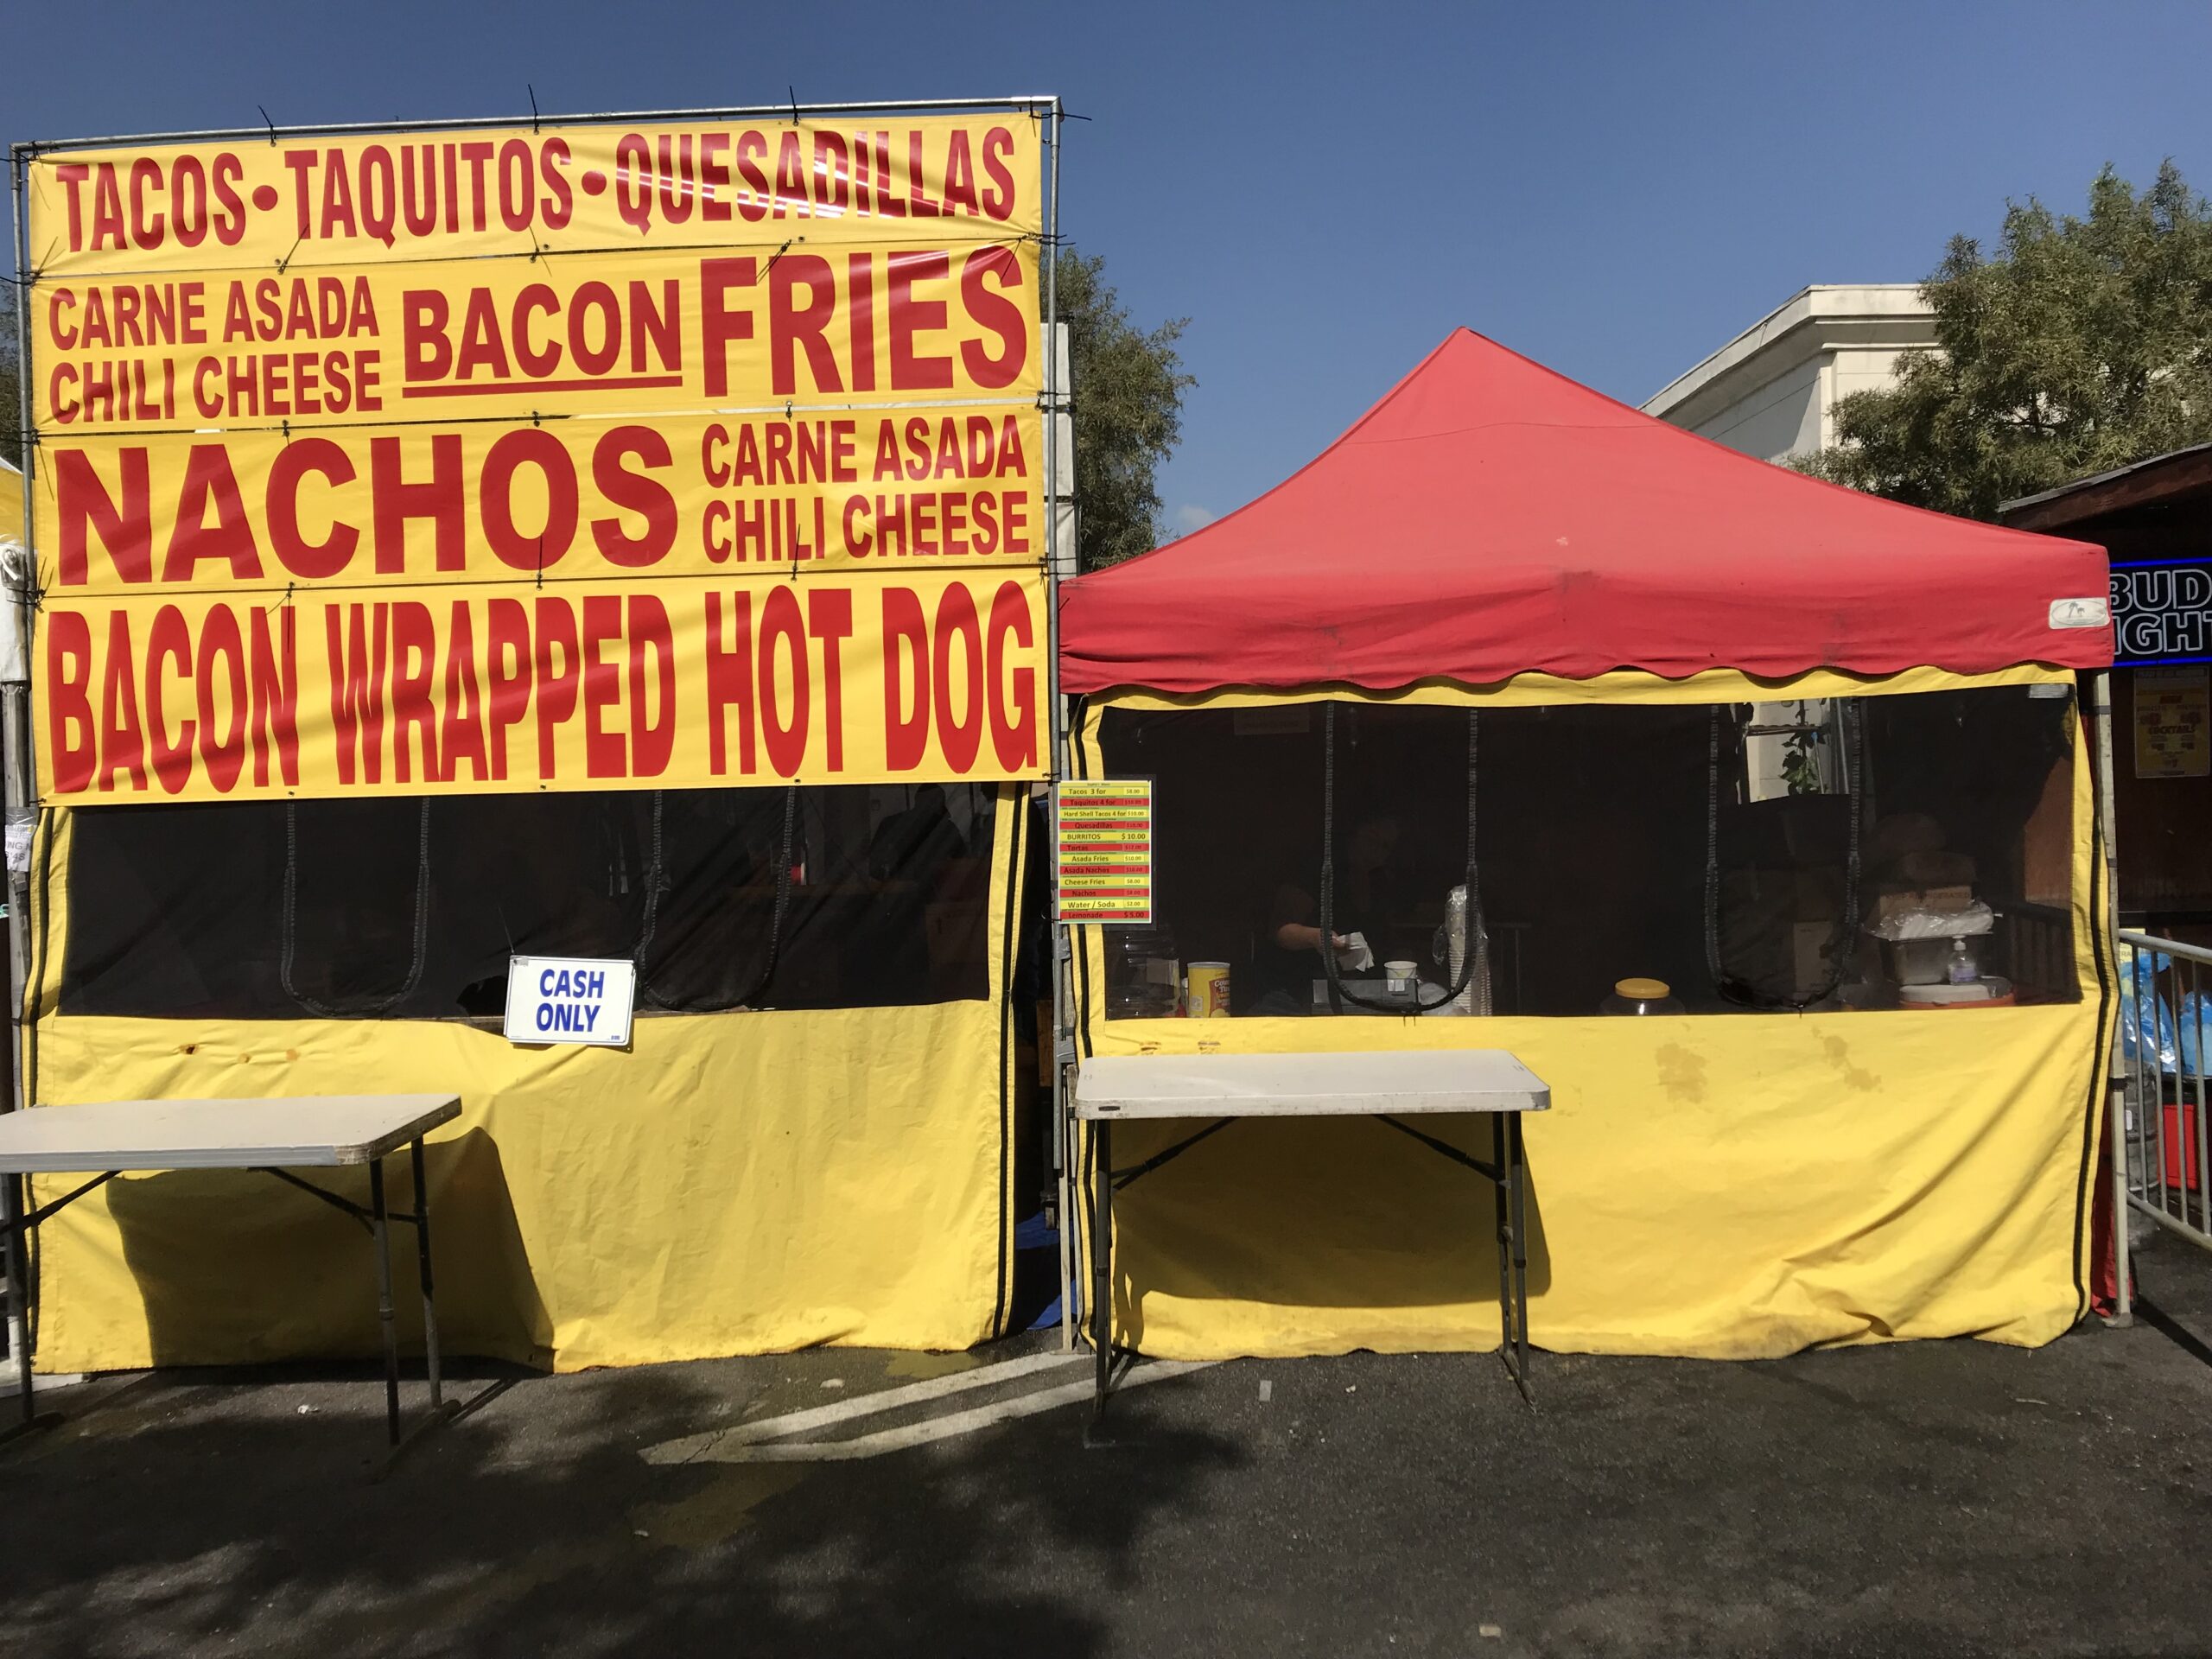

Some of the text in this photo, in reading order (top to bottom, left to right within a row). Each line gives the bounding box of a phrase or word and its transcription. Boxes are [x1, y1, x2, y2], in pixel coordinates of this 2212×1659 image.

[57, 127, 1014, 252] TACOS TAQUITOS QUESADILLAS
[49, 276, 379, 351] CARNE ASADA
[403, 245, 1027, 397] BACON FRIES
[49, 350, 383, 424] CHILI CHEESE
[702, 415, 1027, 489] CARNE ASADA
[54, 425, 678, 586] NACHOS
[702, 491, 1030, 564] CHILI CHEESE
[2109, 569, 2212, 613] BUD
[2113, 610, 2212, 655] IGH
[47, 580, 1037, 794] BACON WRAPPED HOT DOG
[1092, 900, 1096, 909] /
[536, 1002, 601, 1033] ONLY
[539, 969, 605, 999] CASH
